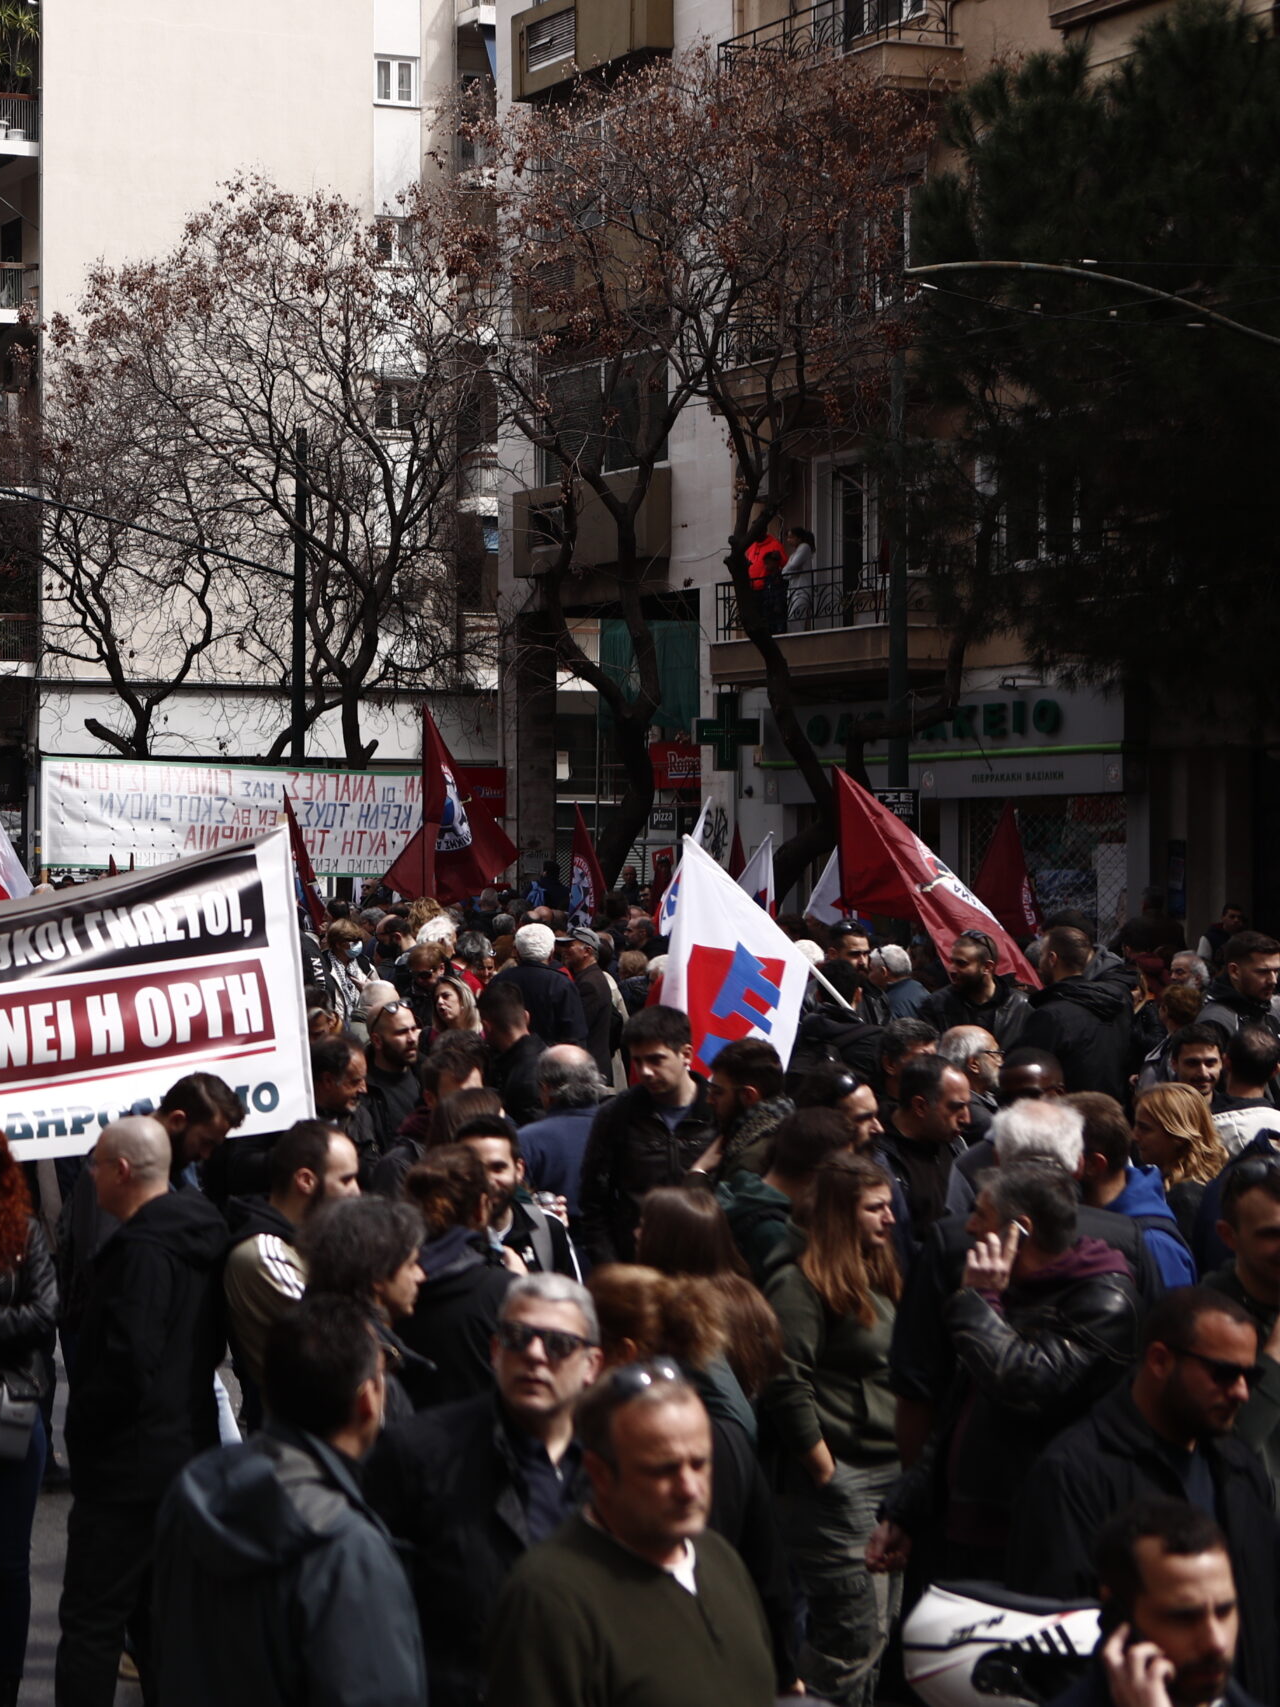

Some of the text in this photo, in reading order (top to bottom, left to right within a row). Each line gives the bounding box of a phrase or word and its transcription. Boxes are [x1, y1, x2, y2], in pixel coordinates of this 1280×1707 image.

[653, 810, 673, 825] pizza
[82, 887, 254, 951] ΓΝΩΣΤΟΙ,
[88, 992, 124, 1055] Η
[136, 971, 266, 1049] ΟΡΓΗ
